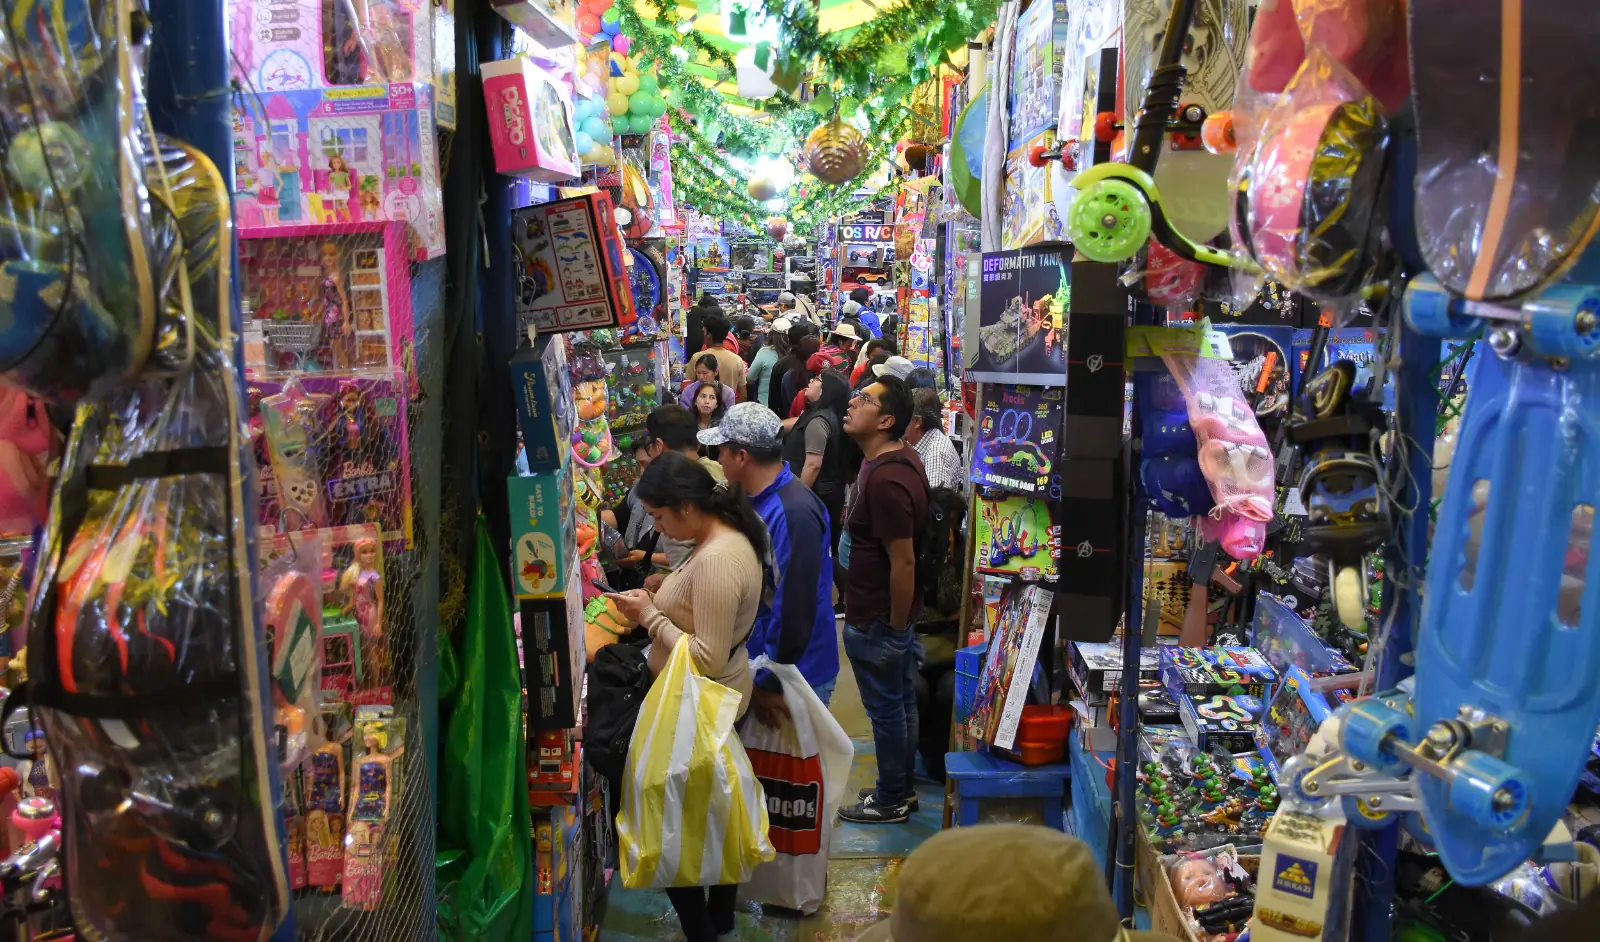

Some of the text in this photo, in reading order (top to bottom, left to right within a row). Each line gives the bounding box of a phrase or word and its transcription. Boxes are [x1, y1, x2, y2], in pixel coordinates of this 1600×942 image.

[839, 226, 891, 239] OS R/C
[983, 254, 1036, 272] DEFORMATIN
[1041, 430, 1053, 440] LED
[334, 473, 392, 498] EXTRA
[307, 844, 343, 862] Barbie
